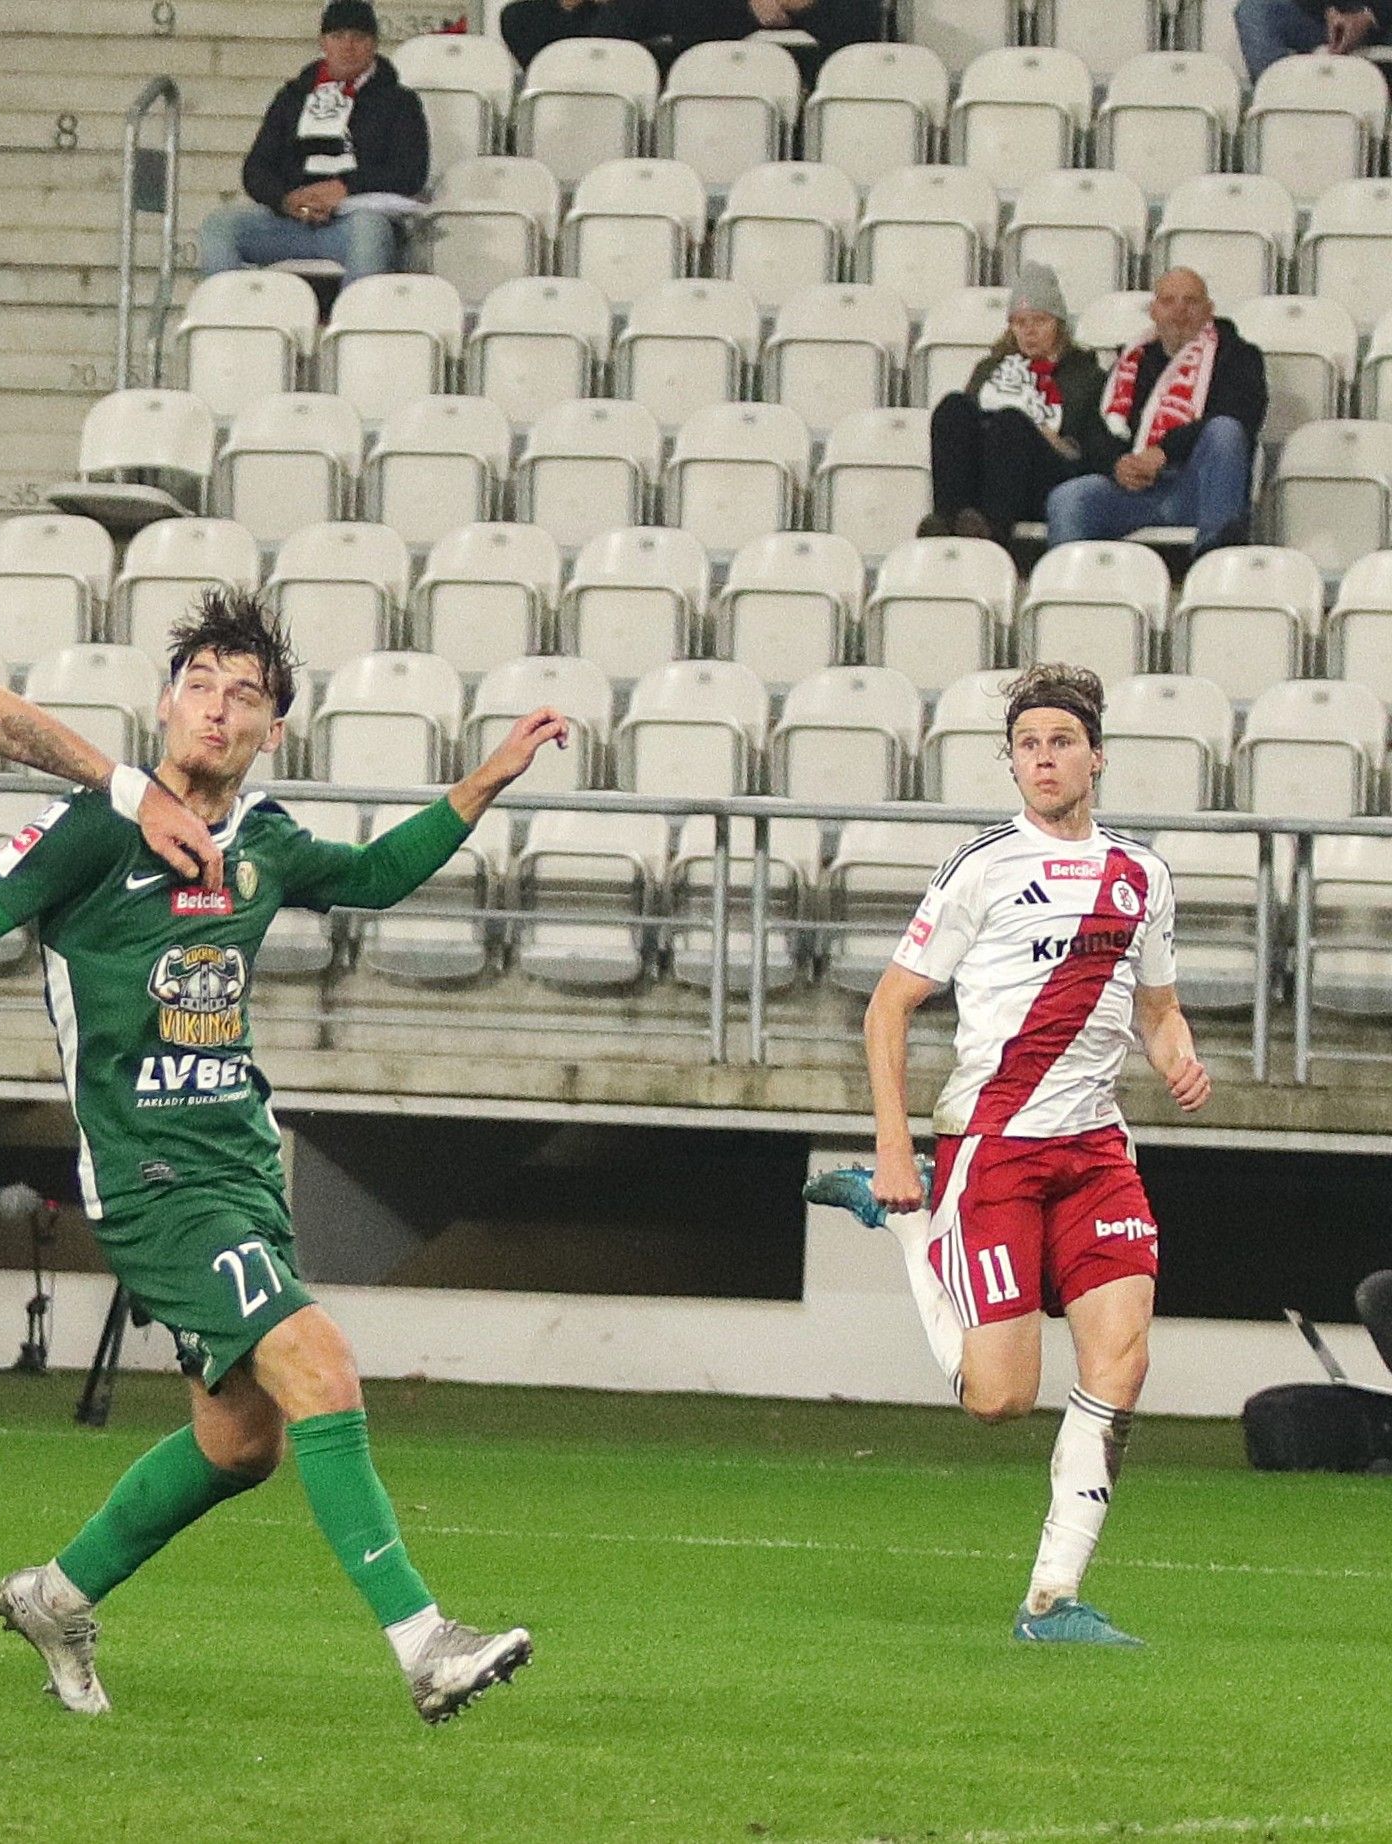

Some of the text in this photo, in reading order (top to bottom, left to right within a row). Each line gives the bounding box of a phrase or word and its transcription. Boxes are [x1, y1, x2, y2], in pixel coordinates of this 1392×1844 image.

[152, 1, 175, 37] 9
[56, 113, 78, 149] 8
[1050, 864, 1097, 877] Betclic
[176, 891, 227, 910] Betclic
[160, 1006, 243, 1045] VIKINGA
[213, 1241, 283, 1319] 27
[977, 1243, 1021, 1305] 11
